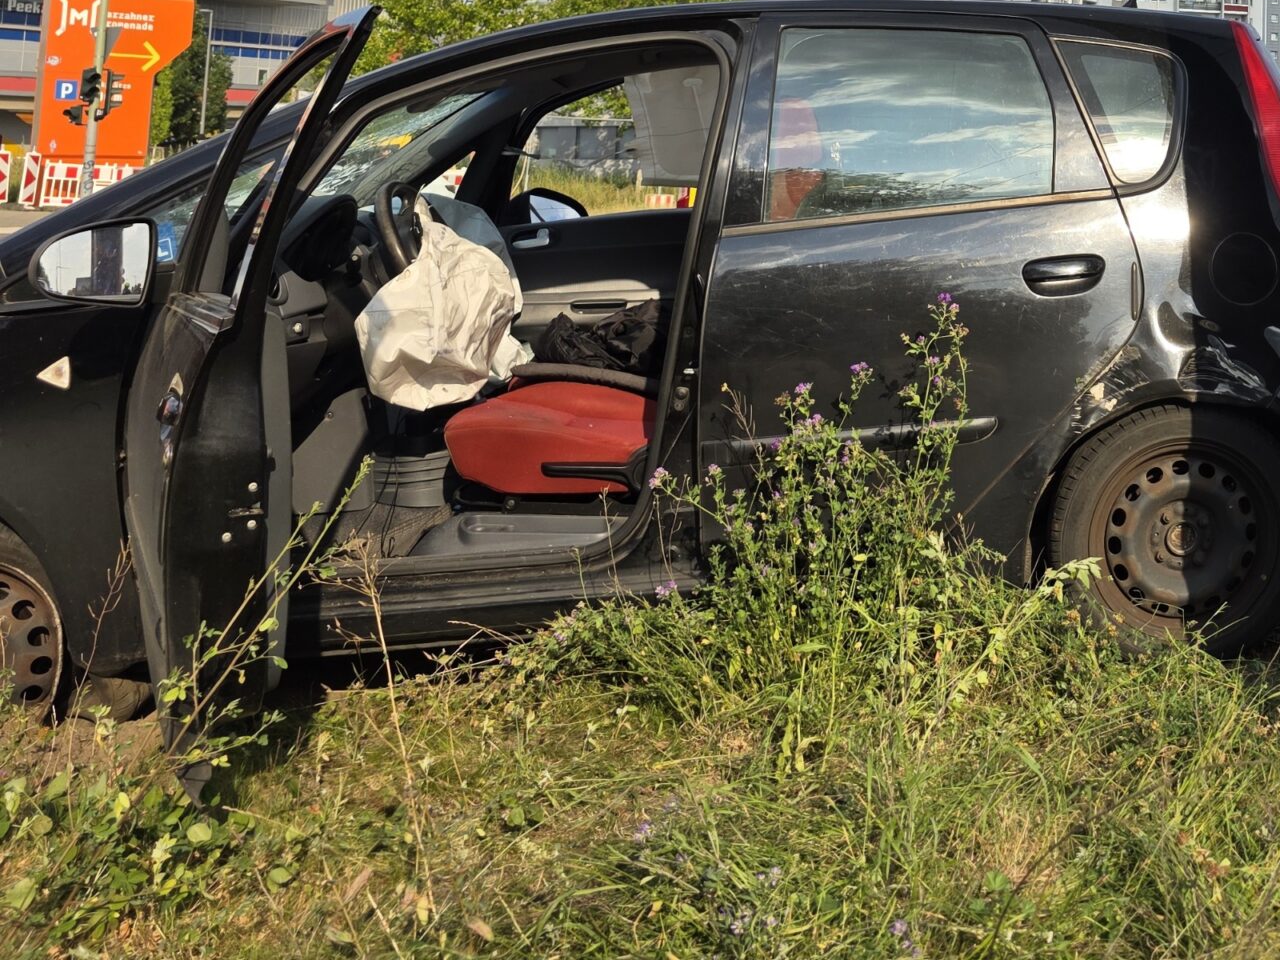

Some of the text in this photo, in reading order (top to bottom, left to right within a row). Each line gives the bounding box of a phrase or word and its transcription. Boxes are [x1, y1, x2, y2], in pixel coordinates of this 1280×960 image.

[107, 11, 155, 22] arzahner
[106, 20, 154, 31] romenade
[60, 82, 73, 98] P
